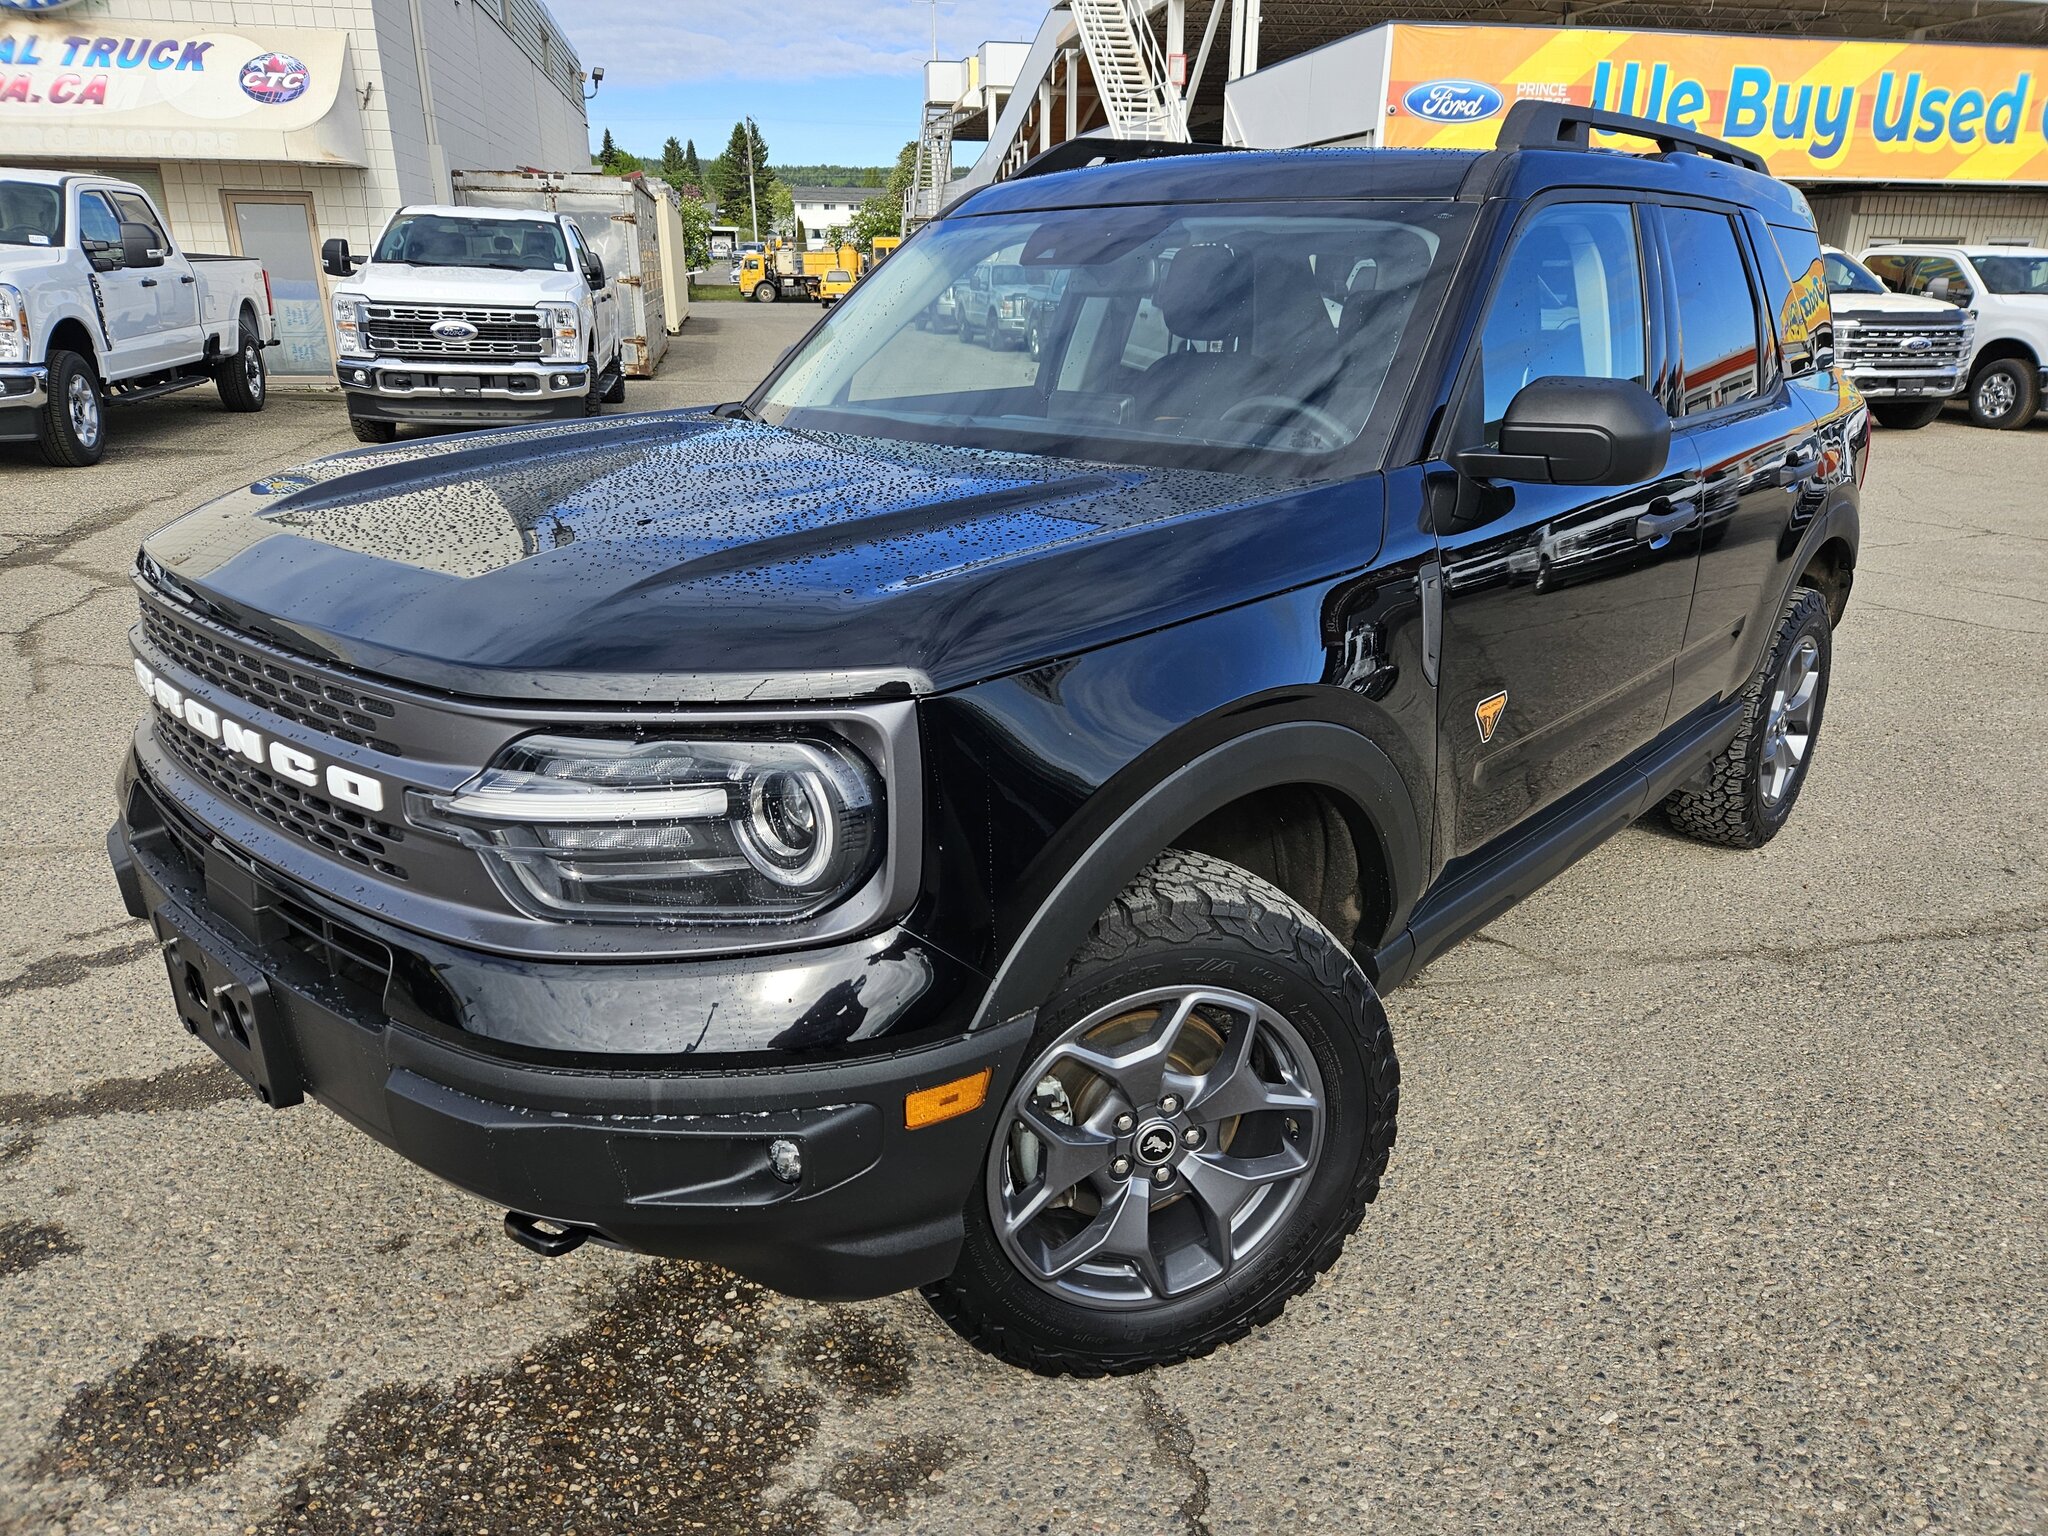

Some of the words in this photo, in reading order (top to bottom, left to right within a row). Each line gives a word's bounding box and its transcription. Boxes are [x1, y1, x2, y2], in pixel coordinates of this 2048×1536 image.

[60, 35, 214, 71] TRUCK
[0, 71, 108, 105] A.CA
[242, 71, 305, 88] CTC
[1516, 82, 1568, 97] PRINCE
[1422, 84, 1484, 116] Ford
[1592, 61, 1705, 136] We
[1722, 64, 1856, 160] Buy
[1871, 71, 2032, 145] Used
[134, 658, 384, 812] BRONCO
